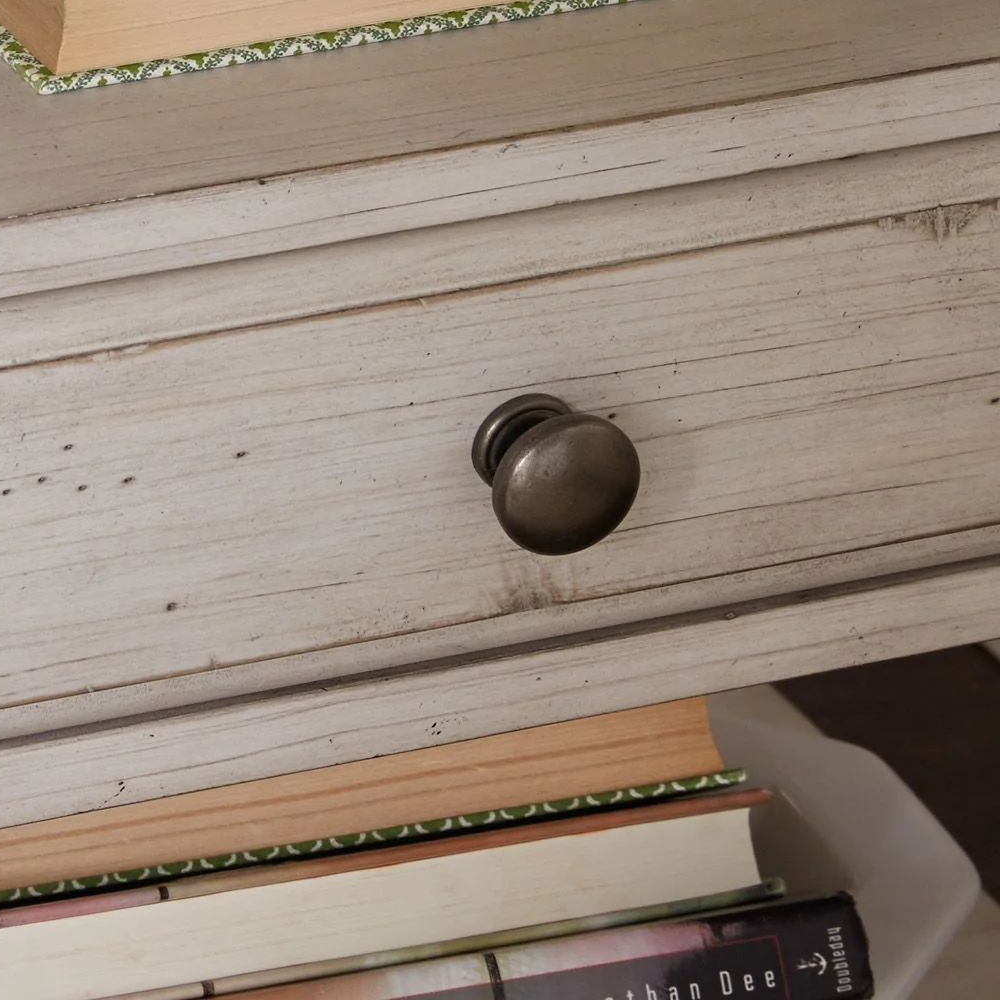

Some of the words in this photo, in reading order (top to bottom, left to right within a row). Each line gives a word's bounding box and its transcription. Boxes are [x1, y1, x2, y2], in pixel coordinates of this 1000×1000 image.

[826, 926, 852, 993] Doubleday
[604, 982, 702, 1000] than
[719, 969, 776, 996] Dee
